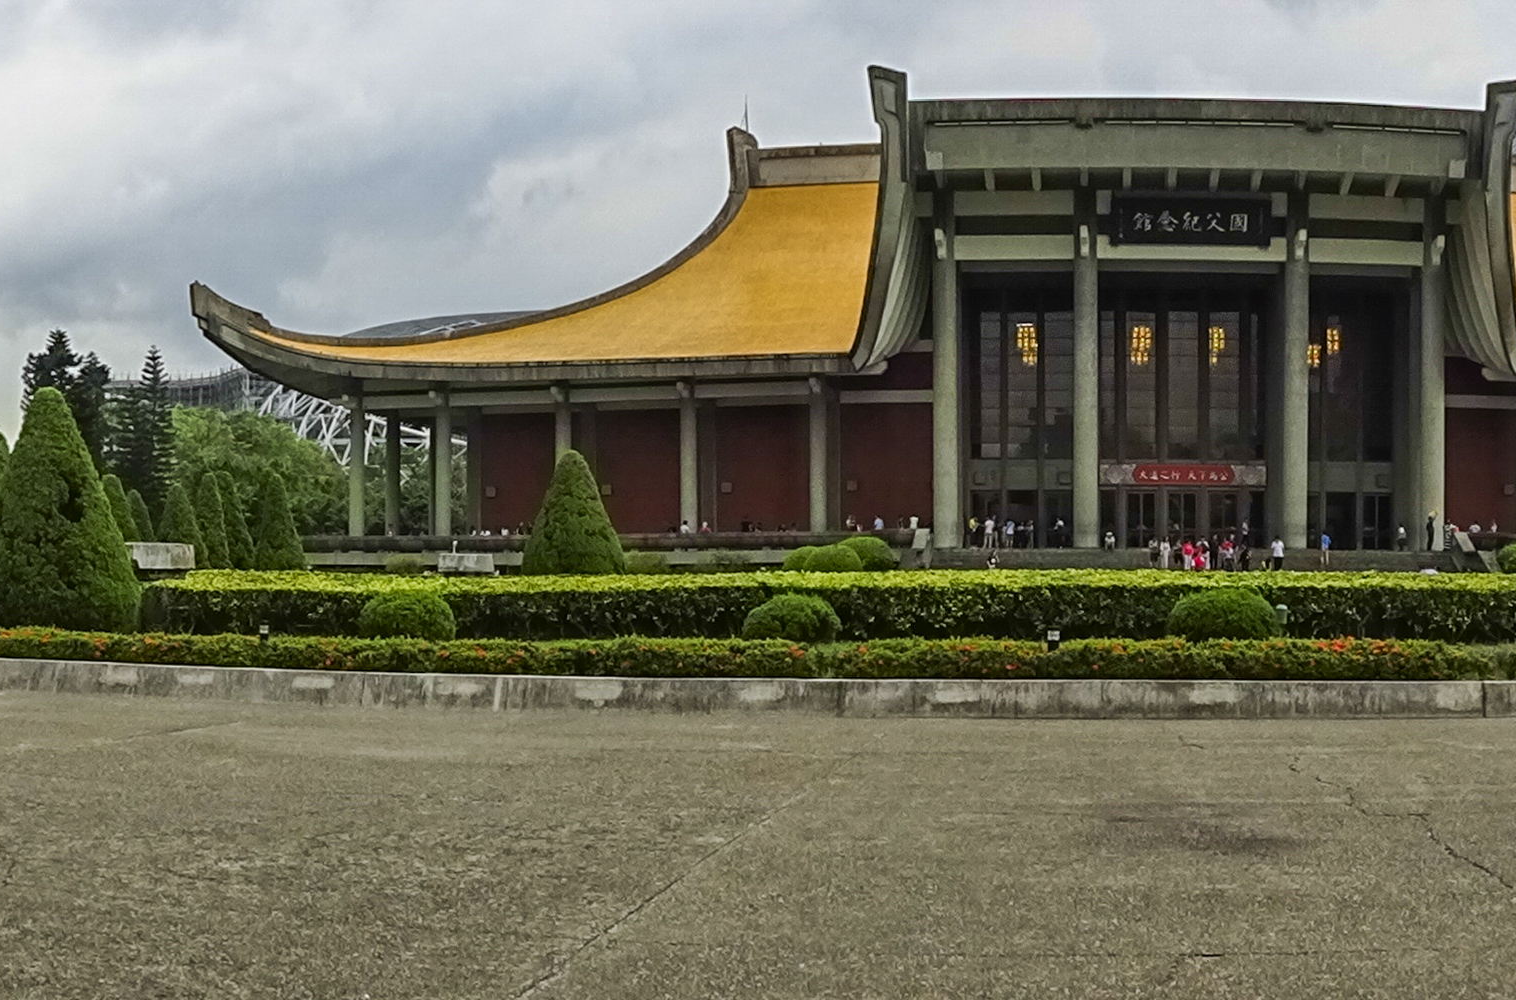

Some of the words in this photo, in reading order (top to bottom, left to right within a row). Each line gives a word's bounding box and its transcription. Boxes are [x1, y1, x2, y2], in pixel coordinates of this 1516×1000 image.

[1133, 210, 1248, 233] 國父紀念館
